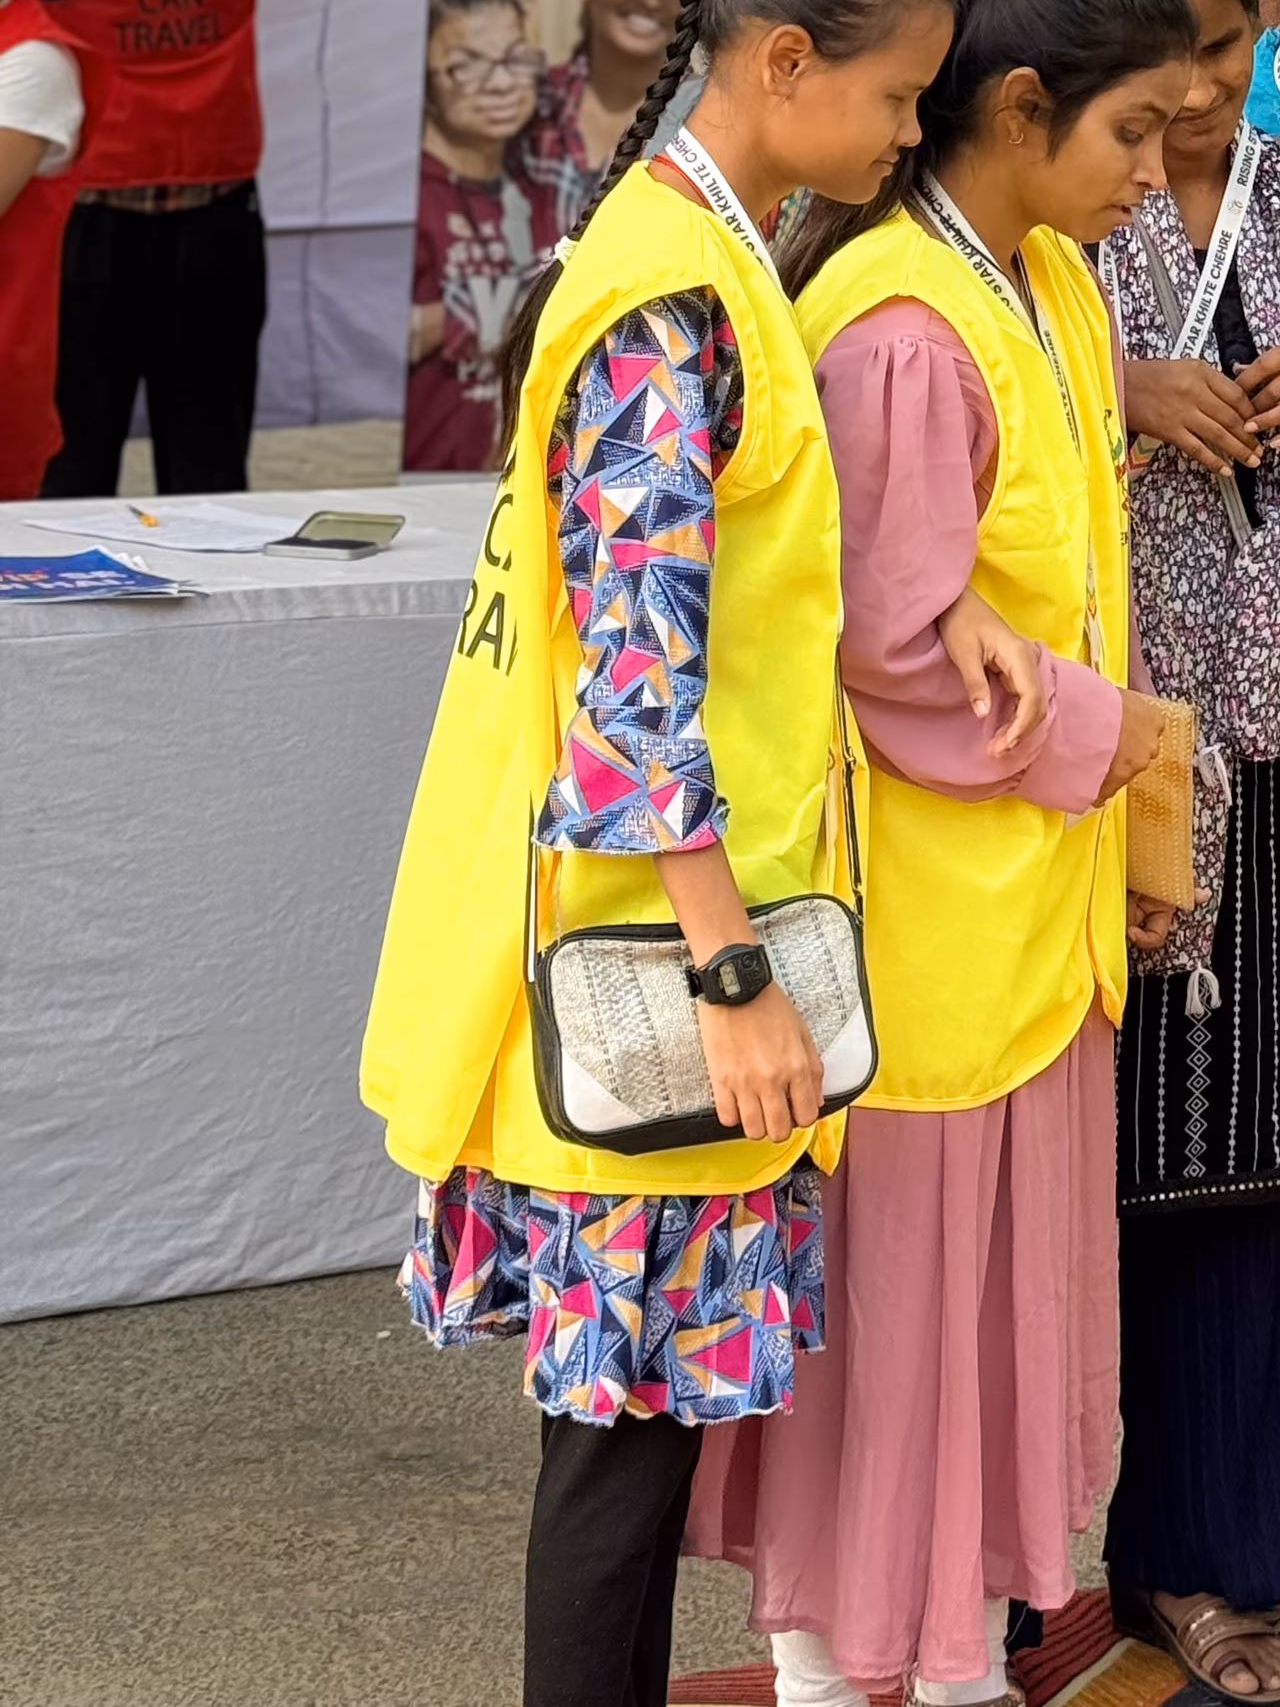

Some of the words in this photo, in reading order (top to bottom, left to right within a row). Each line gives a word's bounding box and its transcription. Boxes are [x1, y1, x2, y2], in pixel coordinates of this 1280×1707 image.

[112, 12, 223, 53] TRAVEL
[1237, 145, 1256, 187] RISING
[693, 162, 732, 213] KHILTE
[973, 258, 1003, 294] STAR
[1181, 326, 1201, 359] STAR
[1194, 280, 1217, 330] KHILTE
[1213, 229, 1233, 280] CHEHRE
